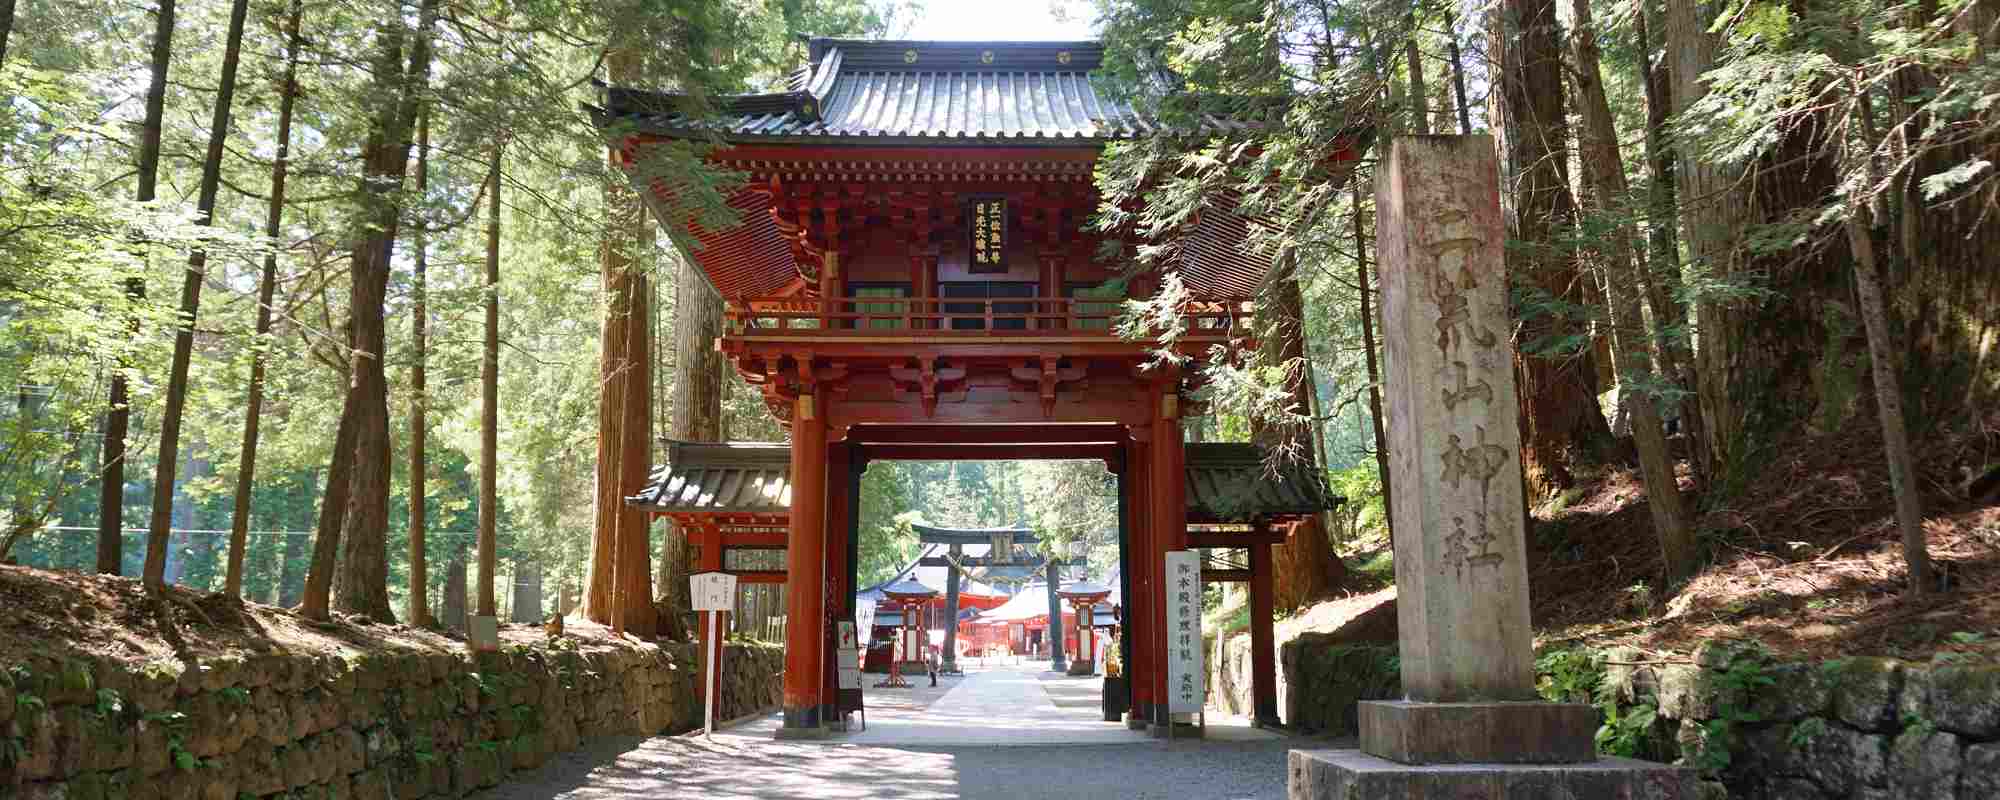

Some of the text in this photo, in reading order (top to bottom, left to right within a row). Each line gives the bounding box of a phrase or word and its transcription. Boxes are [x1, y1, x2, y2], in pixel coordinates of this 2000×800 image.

[1423, 209, 1509, 582] 二荒山神社
